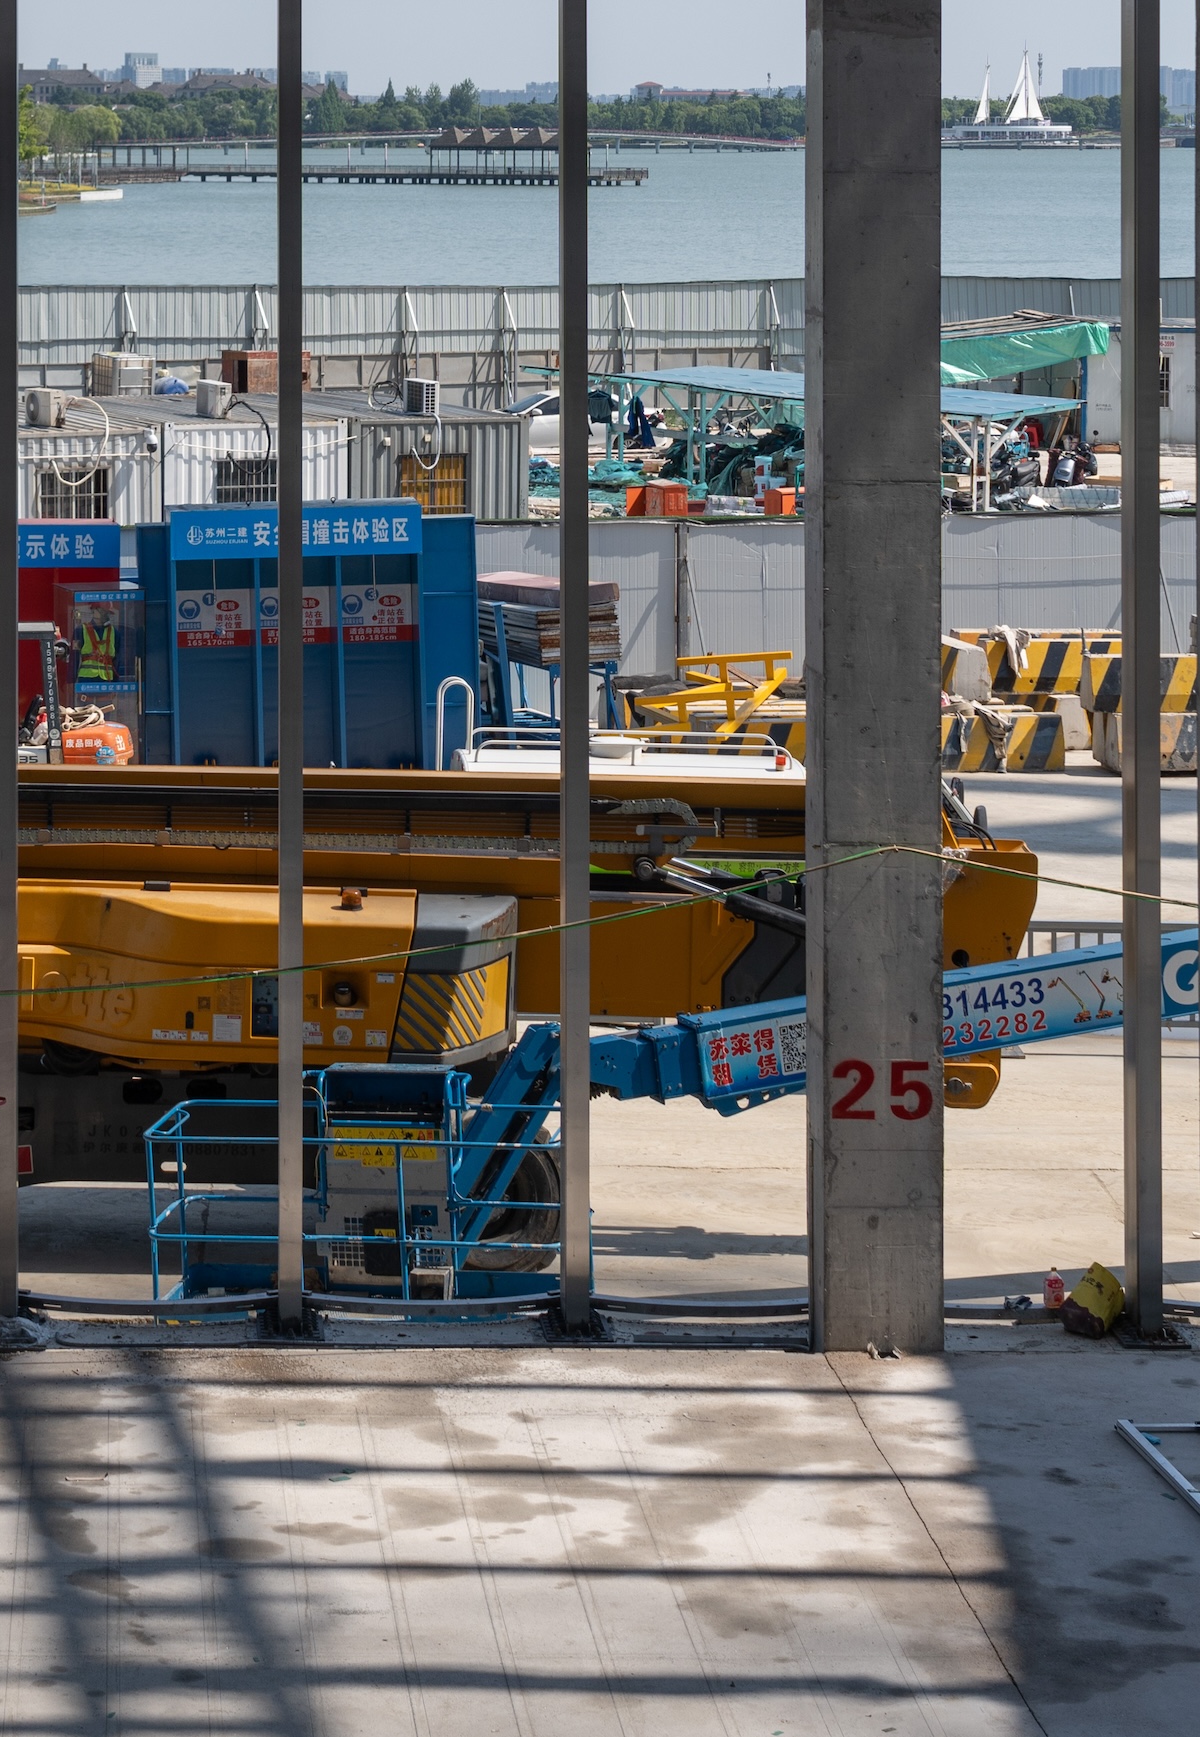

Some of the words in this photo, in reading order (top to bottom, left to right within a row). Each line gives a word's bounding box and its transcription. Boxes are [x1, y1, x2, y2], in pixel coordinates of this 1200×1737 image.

[205, 527, 248, 538] 苏州二建
[65, 738, 103, 748] 废品回收
[943, 1009, 1047, 1047] 232282
[708, 1027, 775, 1061] 苏莱得
[831, 1059, 933, 1121] 25
[167, 1143, 256, 1156] 408807831
